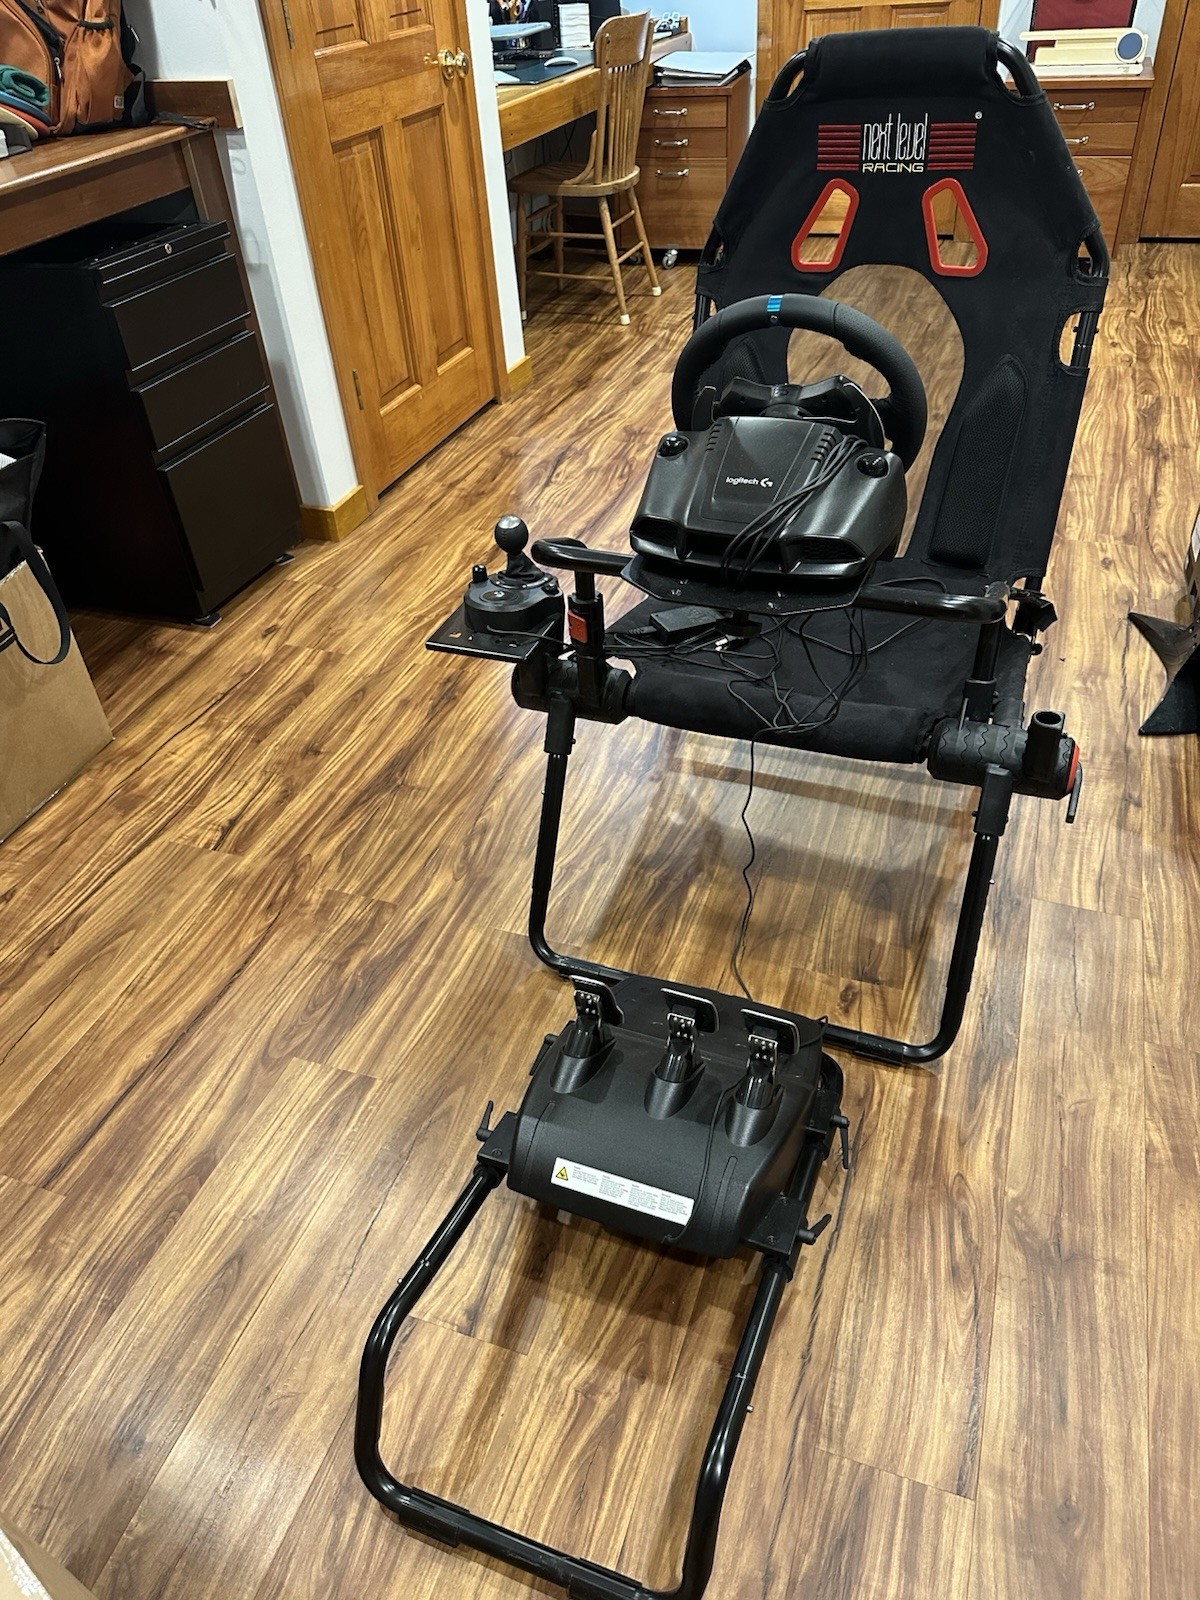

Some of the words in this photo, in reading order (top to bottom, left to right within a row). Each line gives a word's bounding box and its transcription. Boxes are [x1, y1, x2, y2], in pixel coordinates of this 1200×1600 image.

[862, 113, 893, 160] next
[894, 113, 928, 160] level
[862, 162, 925, 173] RACING
[725, 476, 759, 485] logitech
